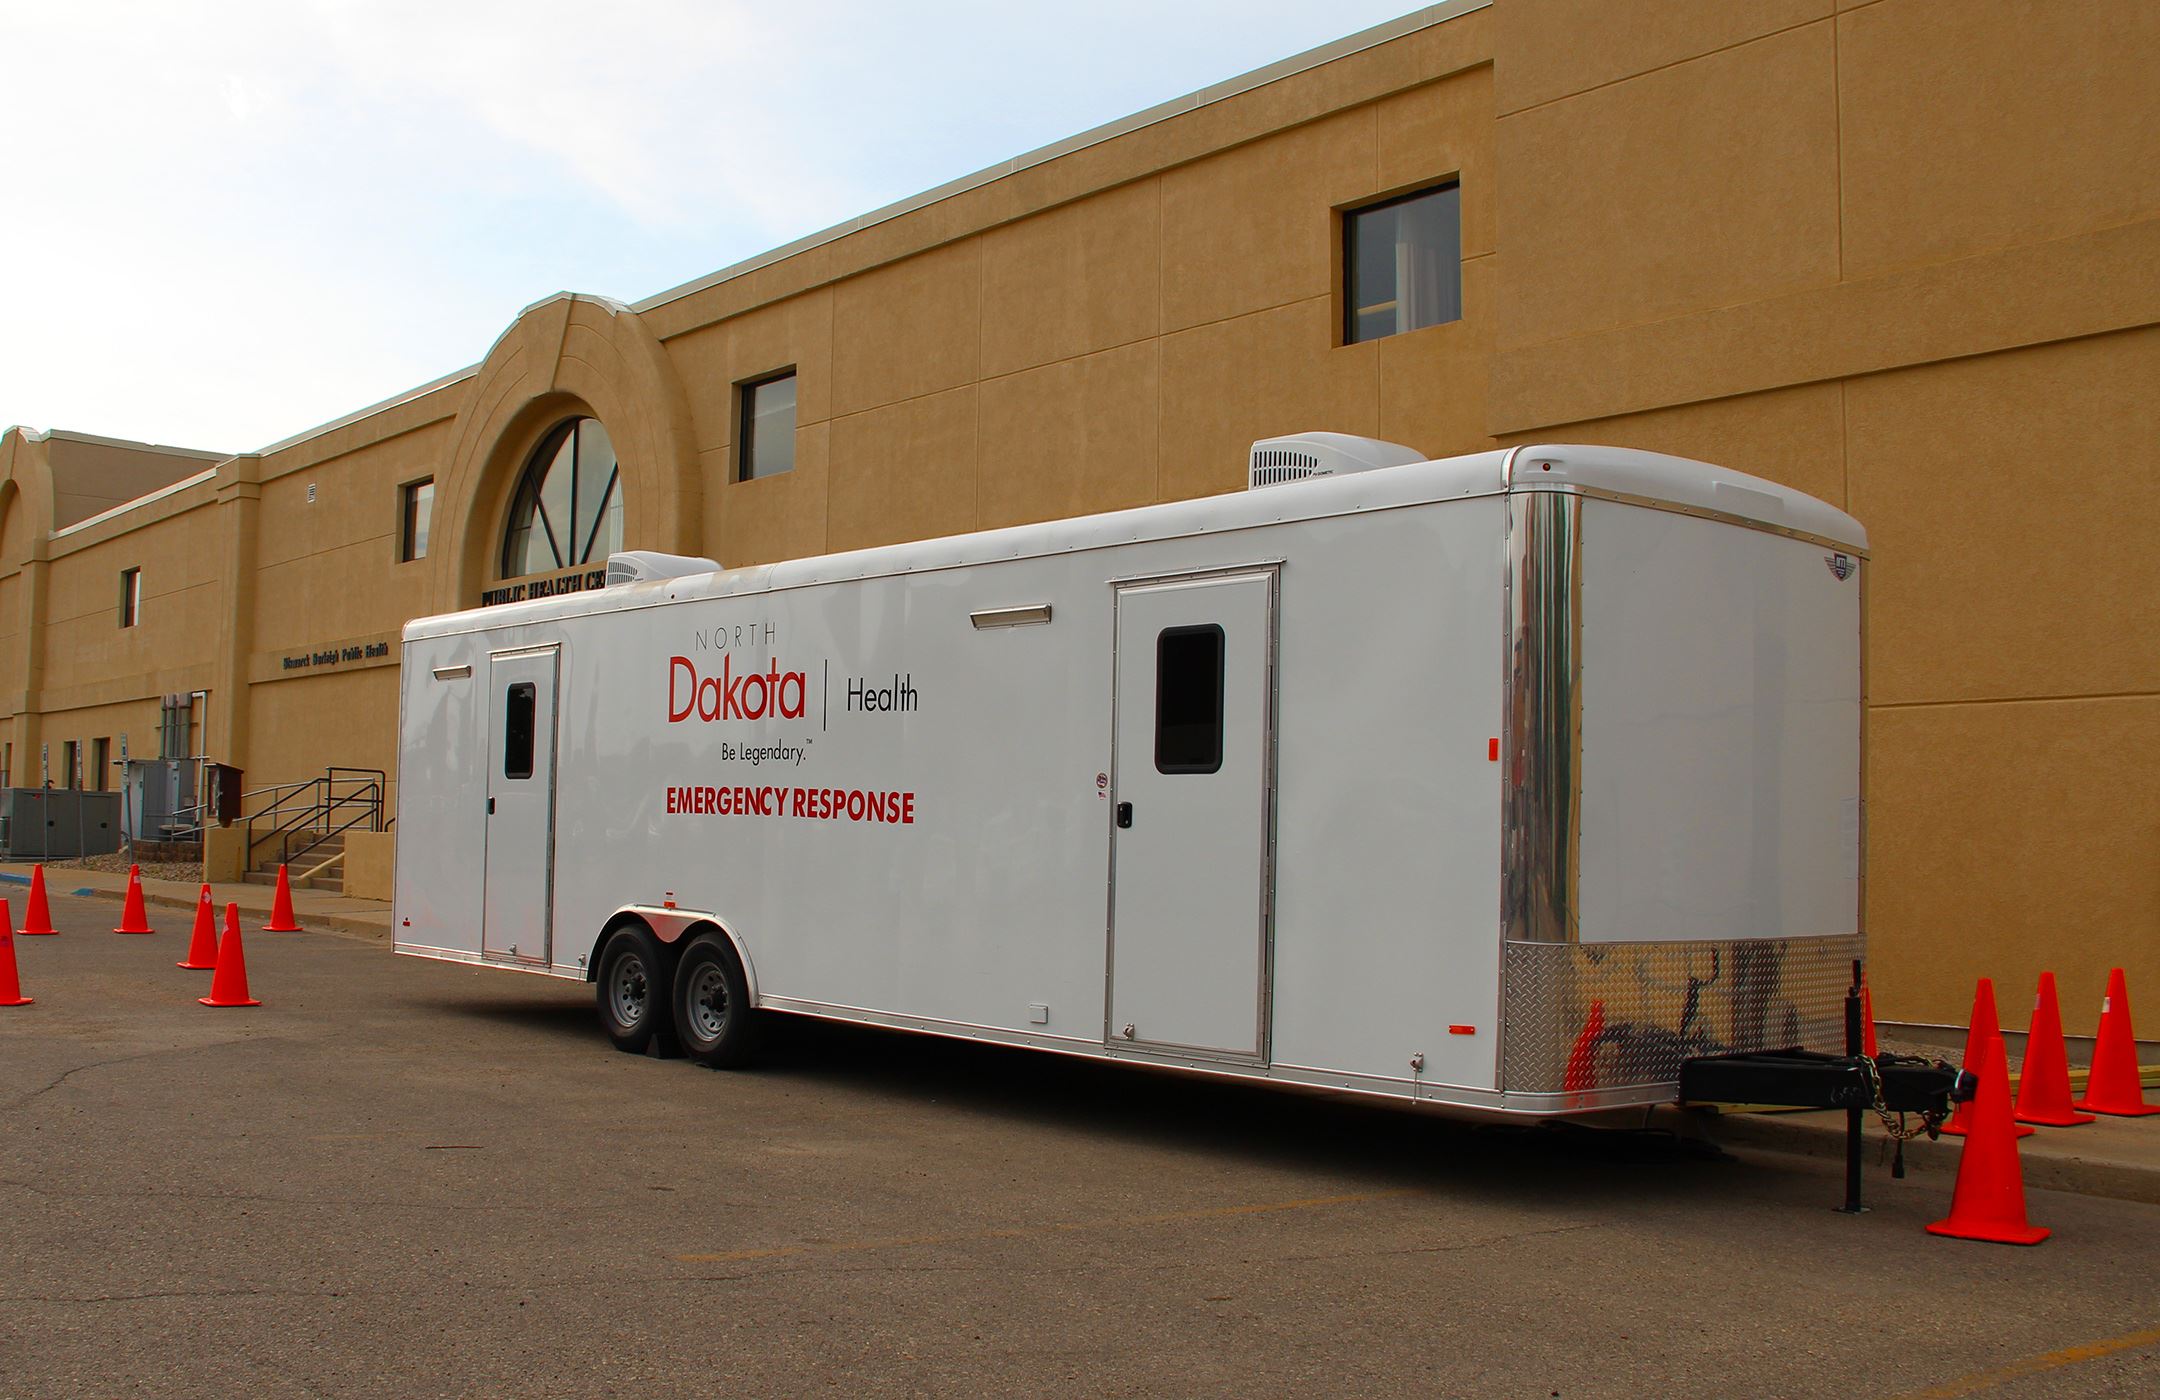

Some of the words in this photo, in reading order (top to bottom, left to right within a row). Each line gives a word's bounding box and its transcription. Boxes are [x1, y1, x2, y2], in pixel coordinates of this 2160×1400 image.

[482, 585, 525, 607] PUBLIC
[528, 574, 583, 600] HEALTH
[341, 646, 363, 661] Public
[365, 642, 388, 658] Health
[695, 622, 776, 651] NORTH
[667, 652, 806, 723] Dakota
[847, 673, 918, 712] Health
[721, 742, 736, 760] Be
[666, 786, 789, 816] EMERGENCY
[792, 787, 915, 824] RESPONSE
